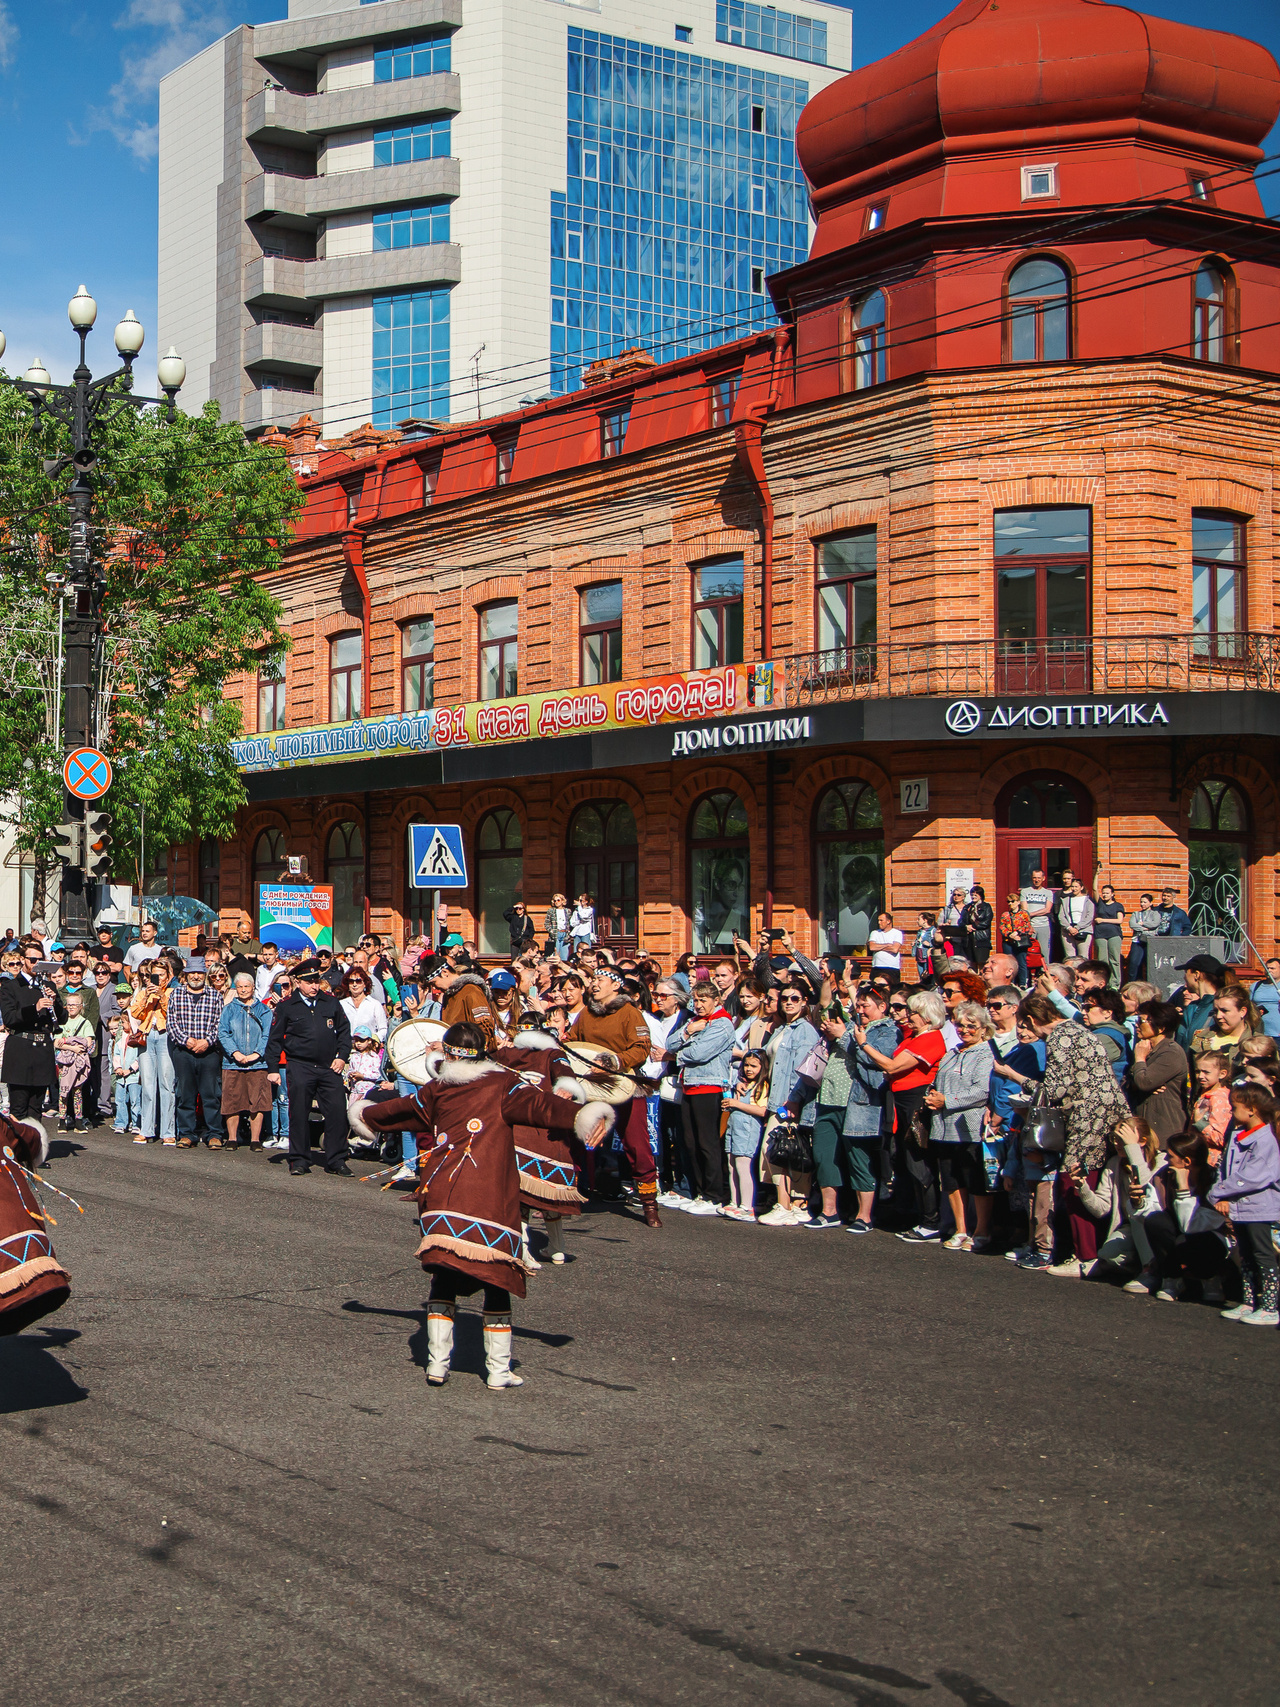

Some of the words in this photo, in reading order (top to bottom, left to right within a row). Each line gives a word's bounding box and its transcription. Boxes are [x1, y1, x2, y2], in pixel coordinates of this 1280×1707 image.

[276, 720, 365, 761] ЛЮБИМЫЙ
[366, 715, 429, 750] ГОРОД!
[435, 706, 470, 746] 31
[476, 703, 530, 741] мая
[537, 693, 608, 736] день
[614, 667, 737, 724] города!
[987, 702, 1169, 727] ДИОПТРИКА
[672, 727, 720, 755] ДОМ
[722, 716, 810, 746] ОПТИКИ
[905, 784, 921, 808] 22
[265, 900, 303, 908] ЛЮБИМЫЙ
[290, 892, 330, 900] РОЖДЕНИЯ,
